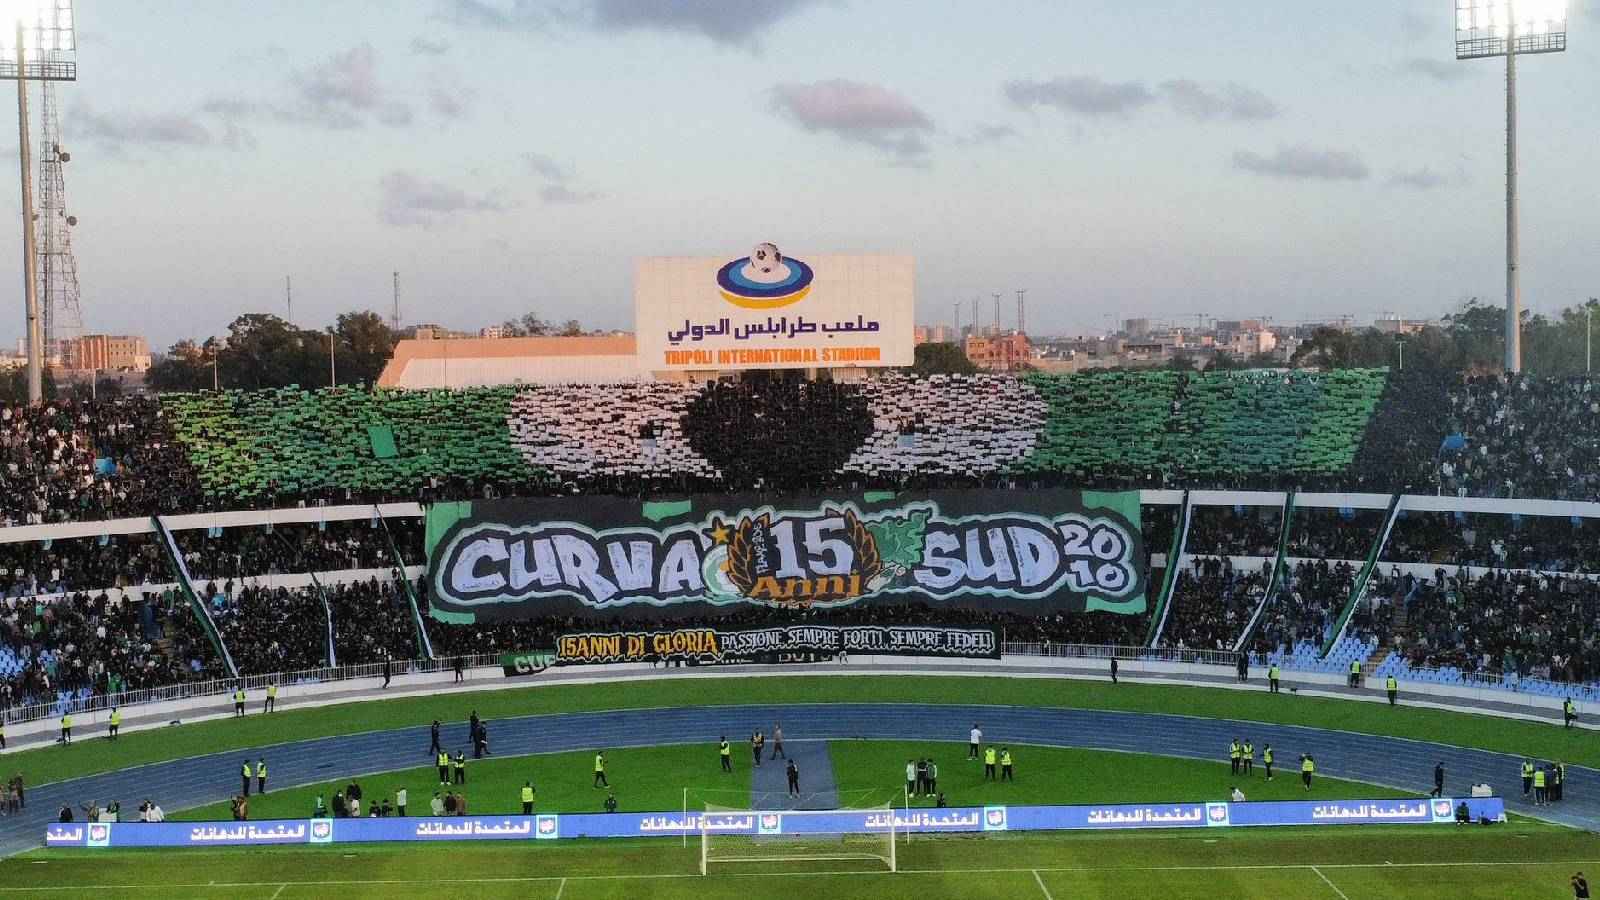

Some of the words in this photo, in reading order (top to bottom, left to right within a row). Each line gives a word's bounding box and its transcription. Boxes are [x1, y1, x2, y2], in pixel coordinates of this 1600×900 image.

[668, 318, 730, 346] الدولي
[735, 316, 817, 341] طرابلس
[821, 315, 880, 338] ملعب
[664, 350, 713, 365] TRIPOLI
[718, 349, 817, 364] INTERNATIONAL
[822, 347, 881, 362] STADIUM
[451, 534, 705, 602] CURVA
[770, 516, 854, 578] 15
[913, 525, 1060, 588] SUD
[627, 634, 645, 656] DI
[652, 631, 718, 655] GLORIA
[721, 631, 783, 650] PASSIONE
[787, 628, 839, 646] SEMPRE
[844, 630, 883, 647] FORTI
[889, 630, 942, 648] SEMPRE
[947, 631, 992, 650] FEDELI
[1145, 807, 1201, 822] المتحدة
[1370, 803, 1426, 817] المتحدة
[474, 820, 531, 834] المتحدة
[697, 815, 753, 829] المتحدة
[922, 812, 979, 826] المتحدة
[248, 824, 305, 839] المتحدة
